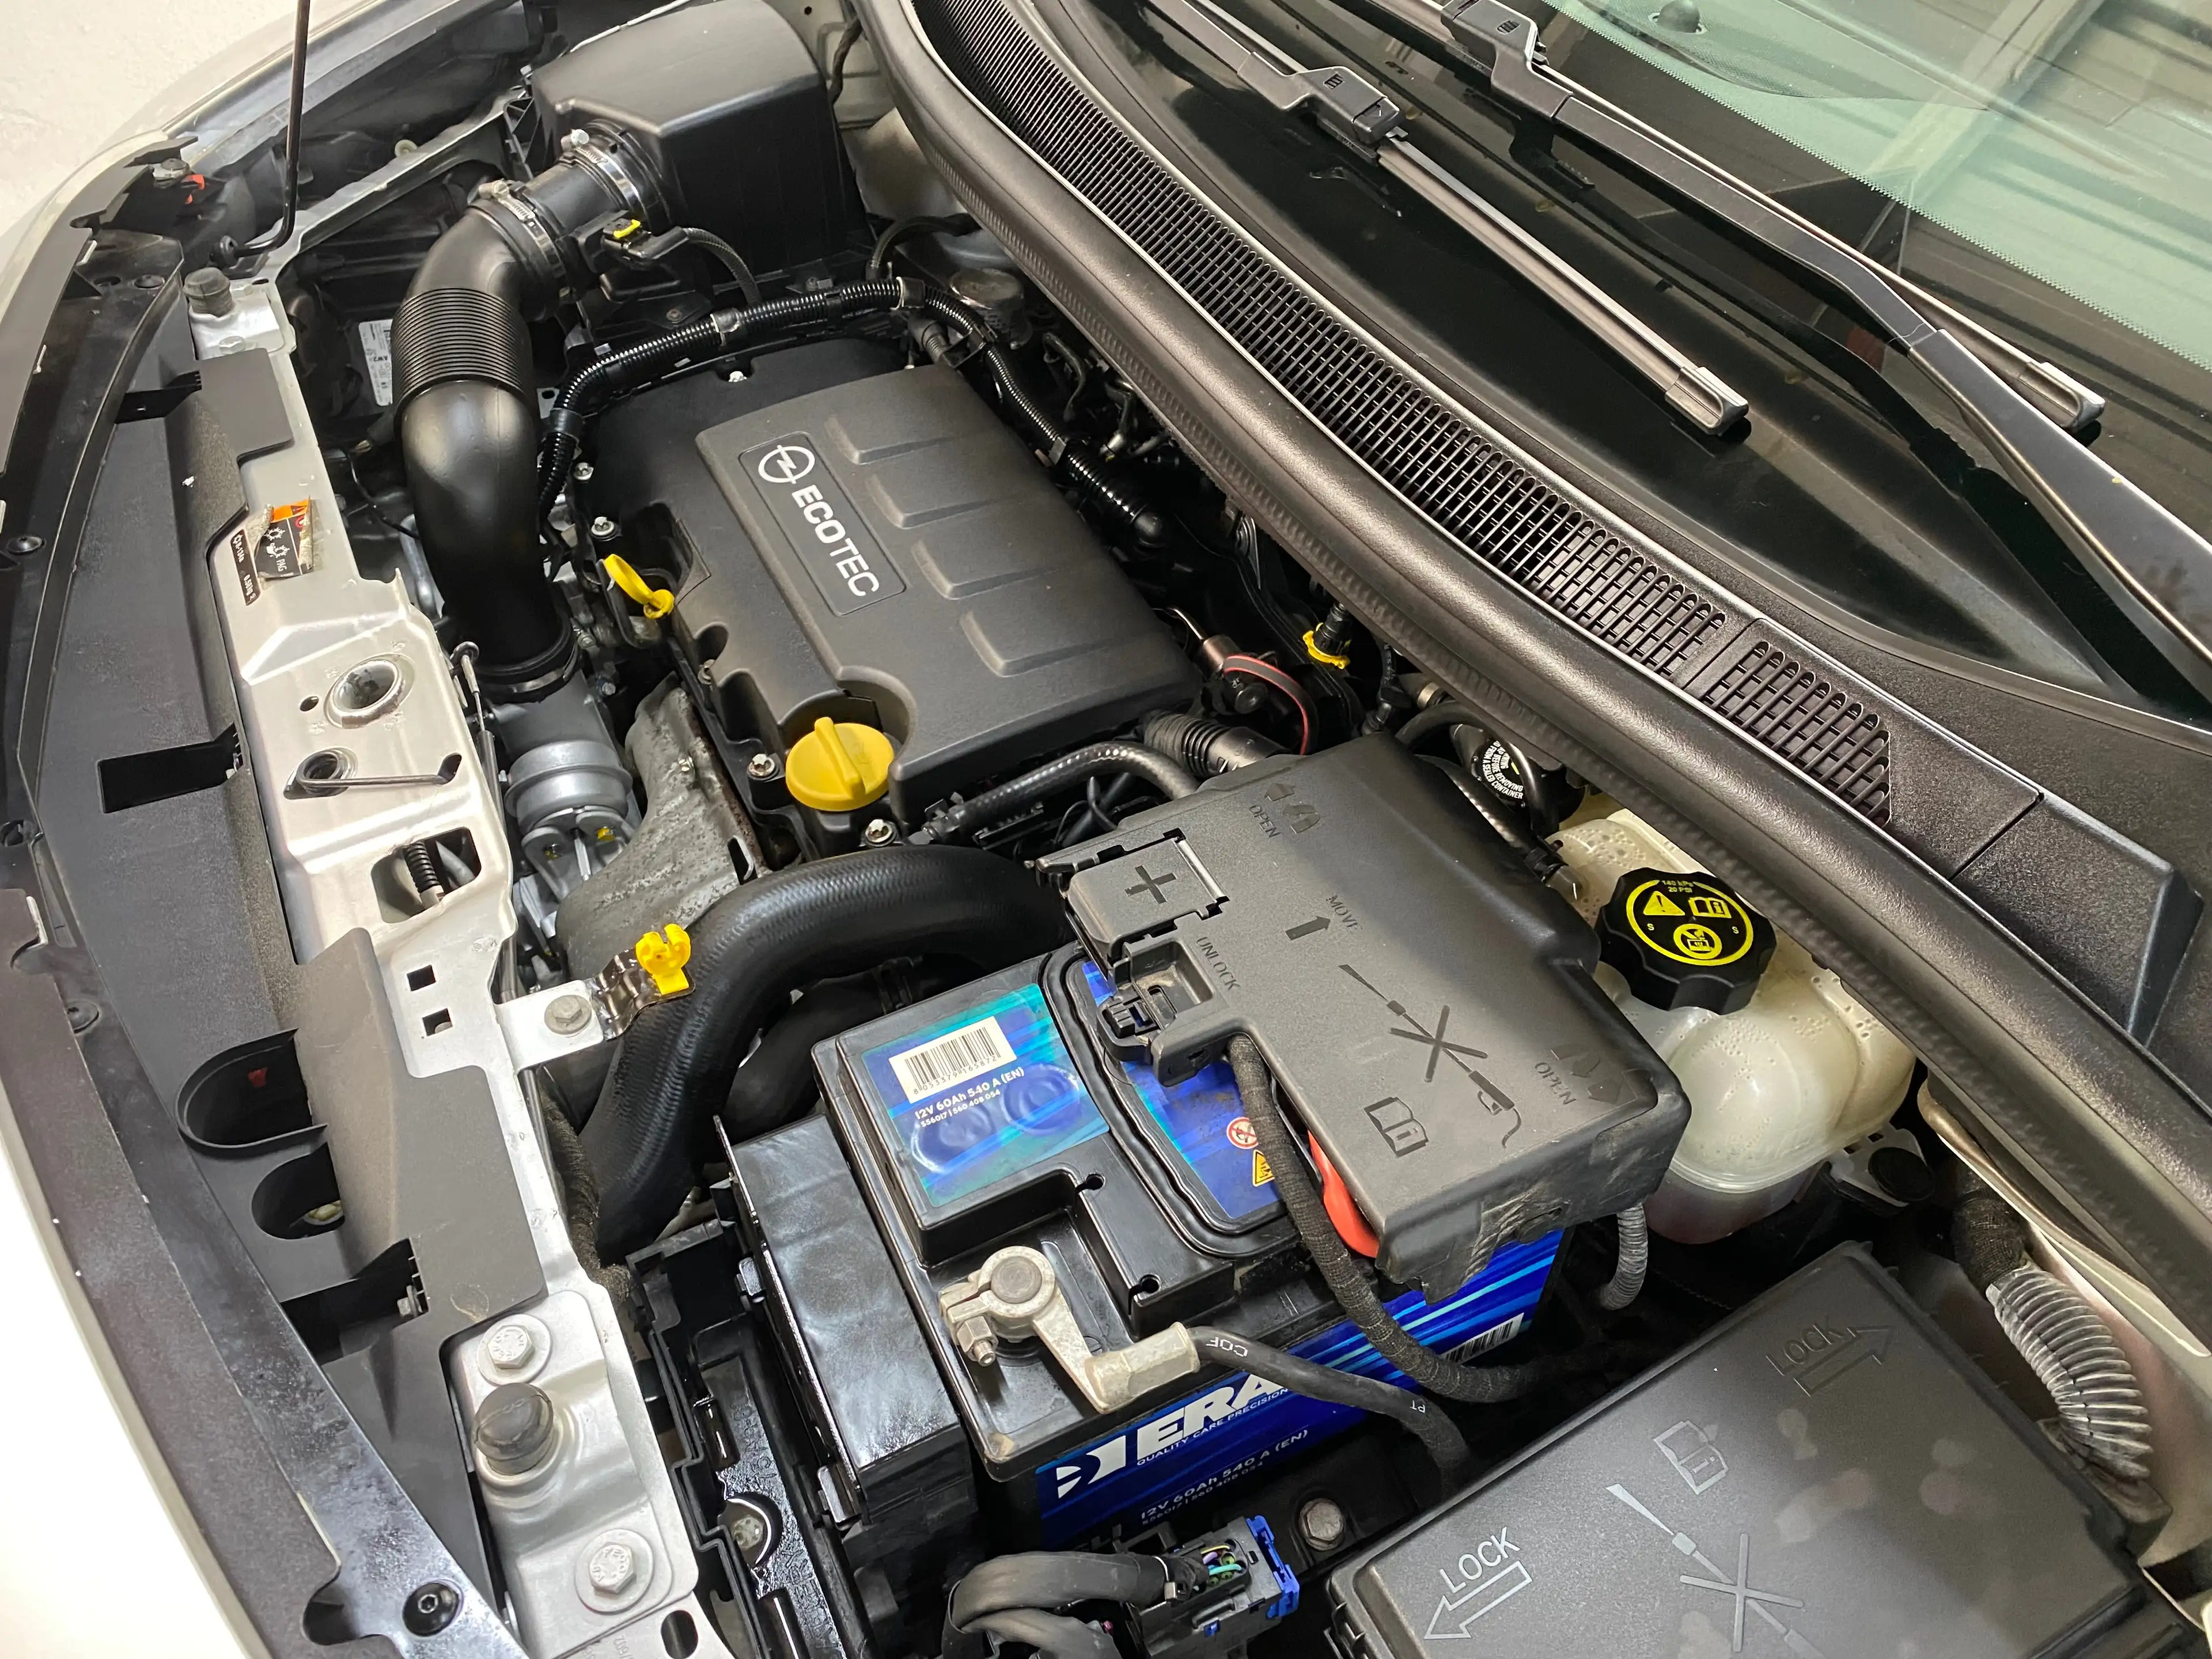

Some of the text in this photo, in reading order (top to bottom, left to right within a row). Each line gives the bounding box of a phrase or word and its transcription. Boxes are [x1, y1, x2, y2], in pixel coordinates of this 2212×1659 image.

[791, 484, 880, 596] ECOTEC
[276, 558, 287, 572] PAG
[1484, 745, 1497, 760] FROM
[1491, 753, 1502, 773] BEFORE
[1482, 764, 1496, 782] SEALED
[1491, 781, 1524, 799] CONTAINER
[1495, 772, 1524, 792] REMOVING
[1249, 805, 1282, 838] OPEN
[1326, 895, 1363, 933] MOVE
[1647, 923, 1654, 931] S
[1732, 926, 1739, 934] S
[1196, 937, 1241, 990] UNLOCK
[914, 1066, 1025, 1120] 12V 60Ah 540 A (EN)
[1535, 1062, 1577, 1105] OPEN
[953, 1103, 968, 1115] 560
[969, 1097, 984, 1107] 408
[985, 1089, 1001, 1100] 054
[1766, 1313, 1845, 1376] LOCK
[1137, 1373, 1284, 1460] ERA
[1137, 1388, 1289, 1466] QUALITY CARE PRECISION
[1141, 1429, 1308, 1520] 12V 60Ah 540 A (EN)
[1440, 1527, 1521, 1593] LOCK
